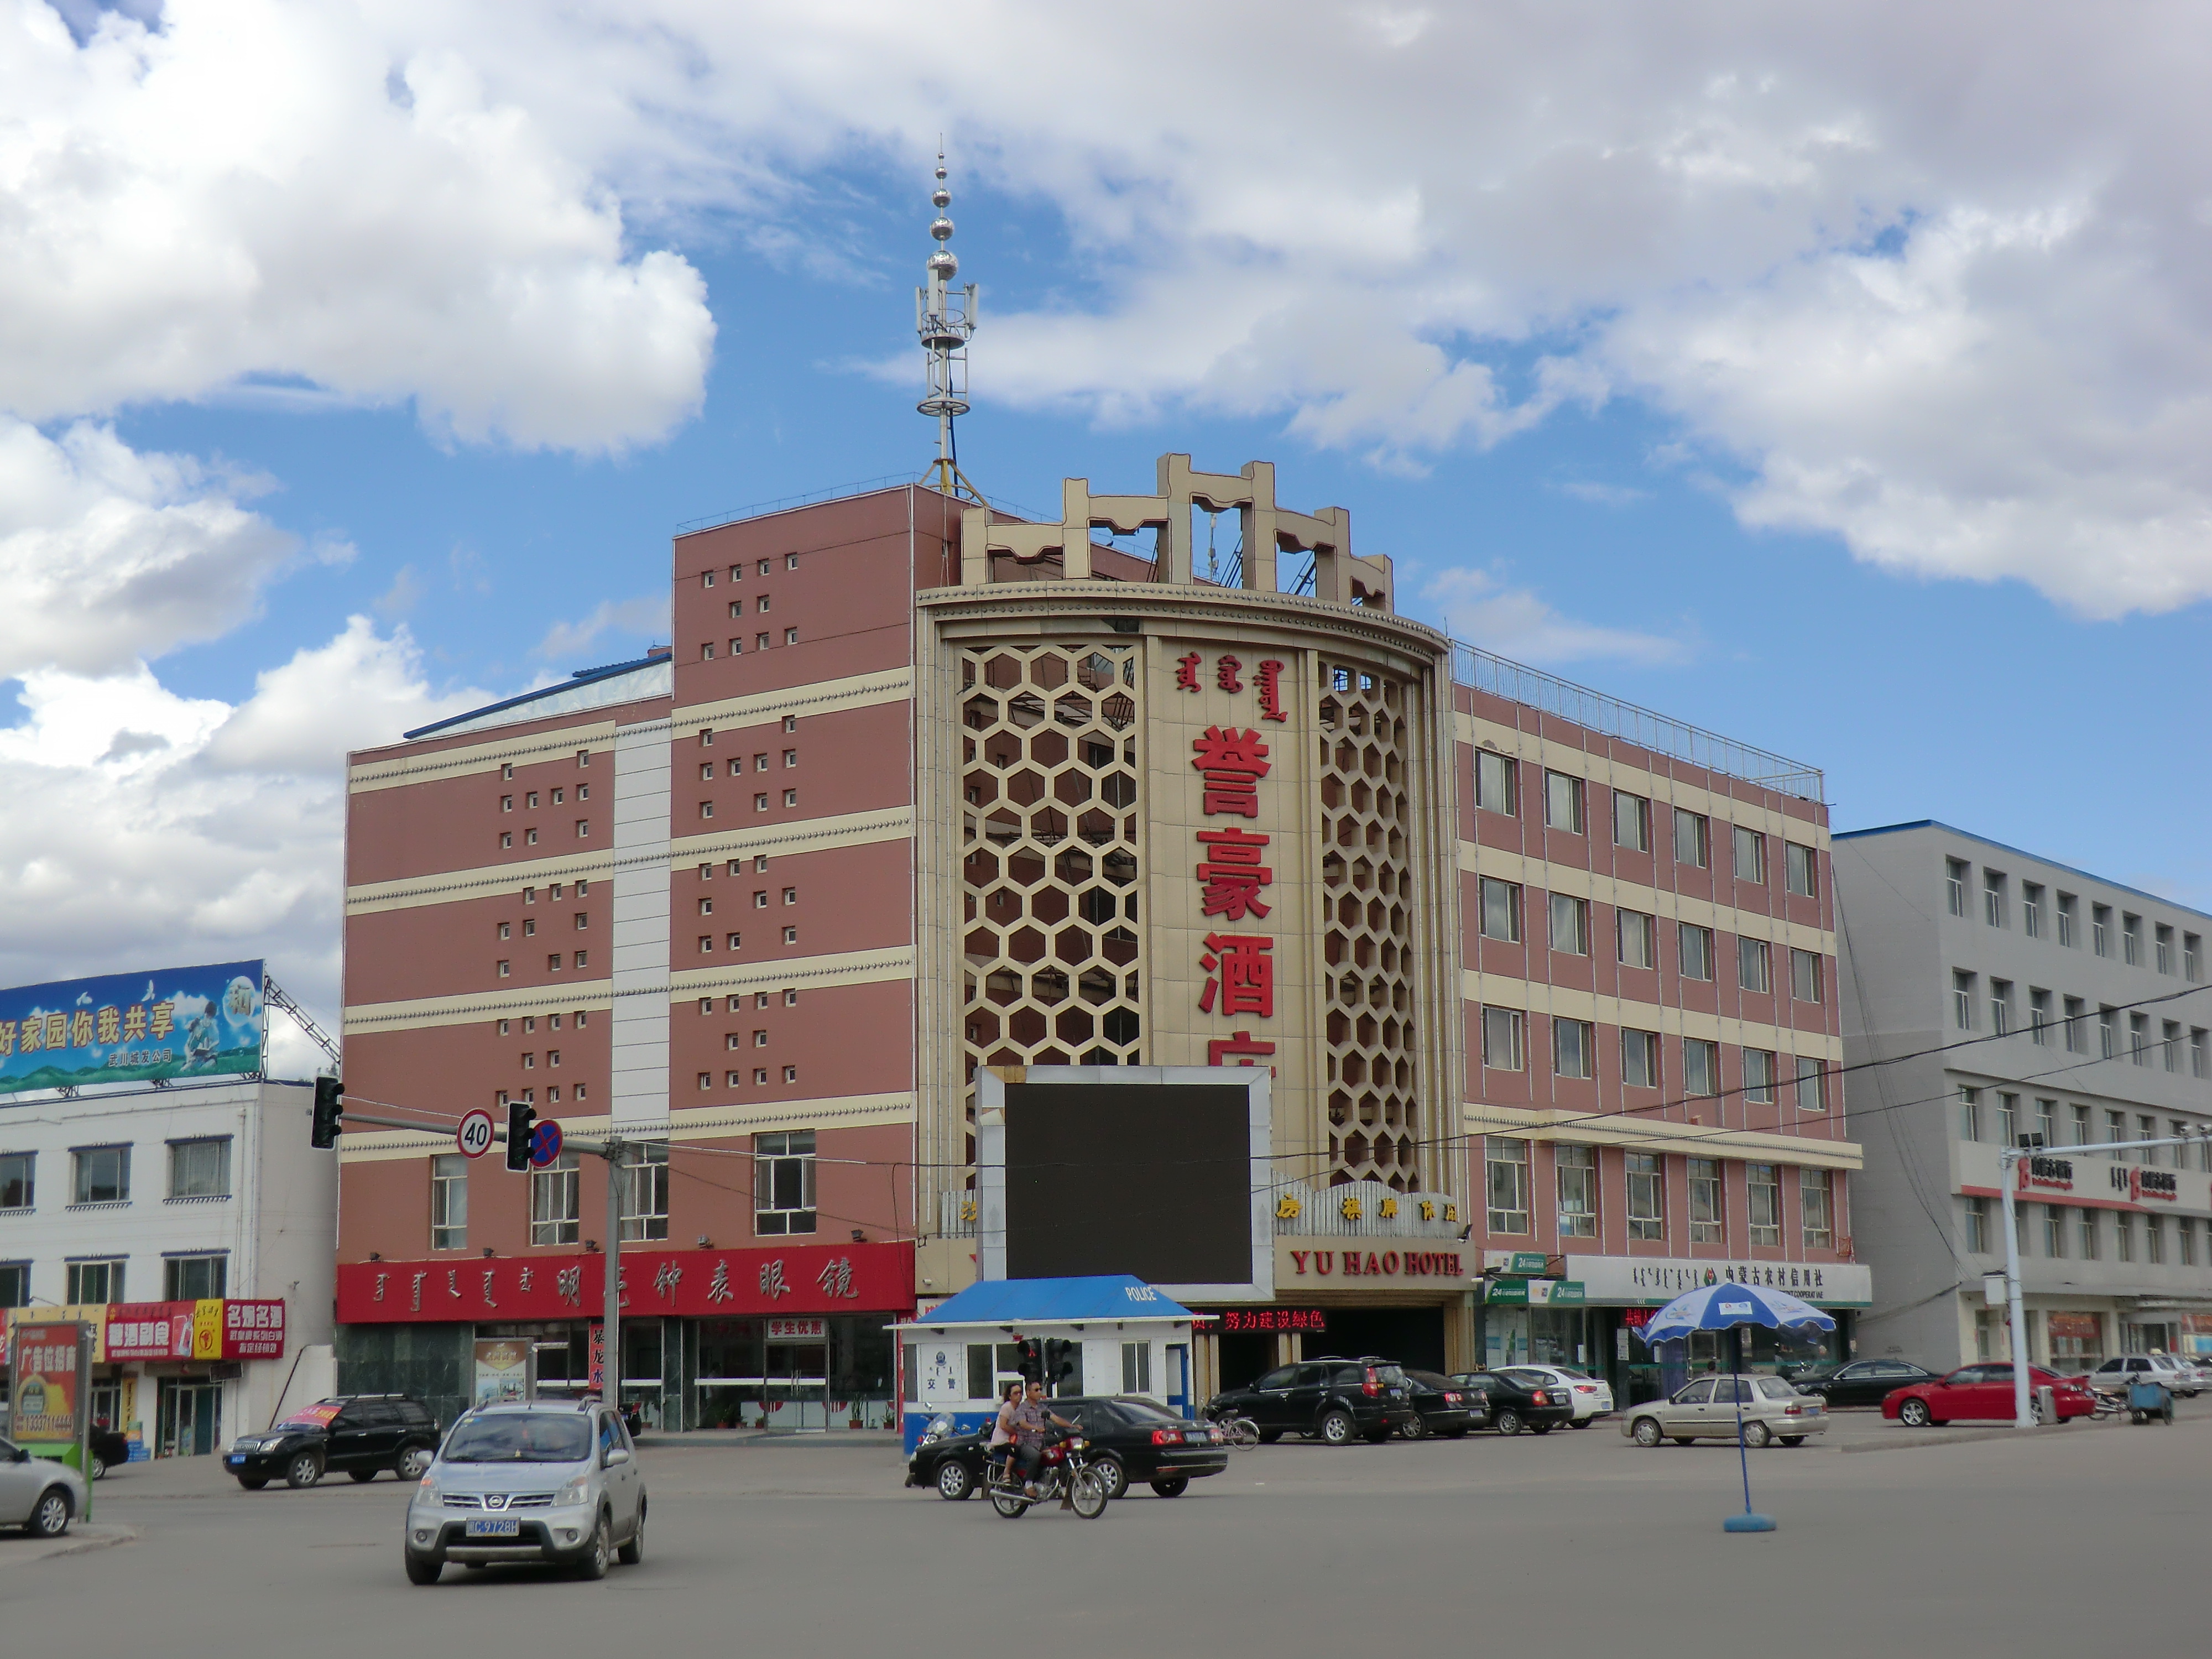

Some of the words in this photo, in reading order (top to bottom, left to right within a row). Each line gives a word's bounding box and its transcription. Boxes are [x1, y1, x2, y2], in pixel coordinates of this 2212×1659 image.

[108, 1048, 172, 1067] 武川城发公司
[465, 1122, 487, 1146] 40
[1290, 1250, 1334, 1275] YU
[1343, 1250, 1400, 1275] HAO
[1404, 1251, 1464, 1276] HOTEL
[1124, 1286, 1158, 1302] POLICE
[771, 1320, 822, 1335] 学生优惠
